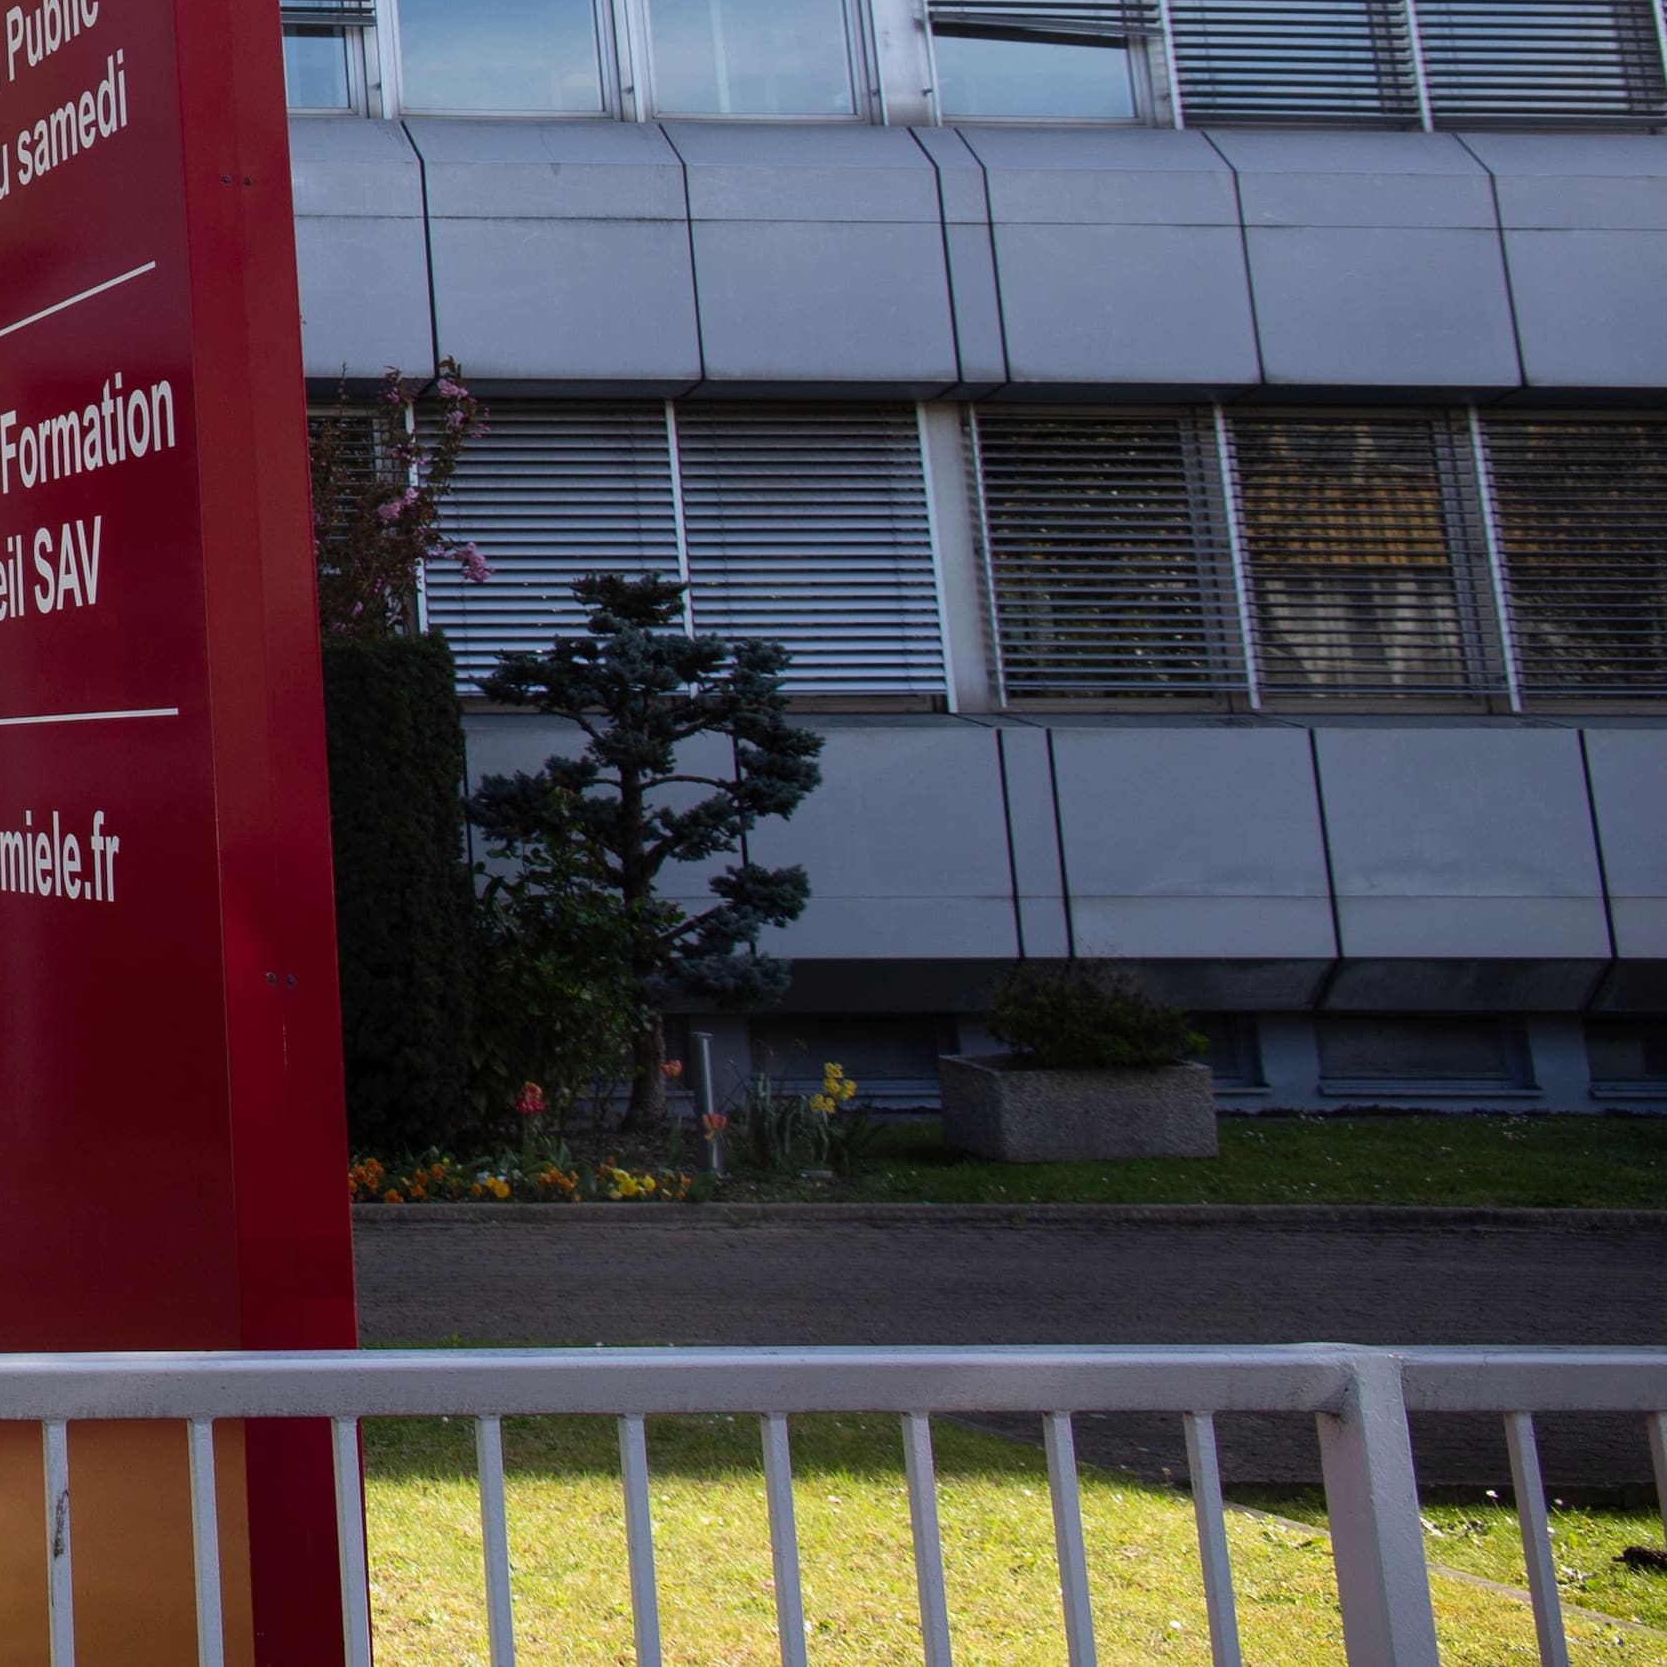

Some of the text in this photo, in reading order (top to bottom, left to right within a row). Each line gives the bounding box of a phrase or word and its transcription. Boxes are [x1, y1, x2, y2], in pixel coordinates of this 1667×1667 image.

[17, 48, 128, 186] samedi
[0, 371, 176, 495] Formation
[33, 515, 101, 614] SAV
